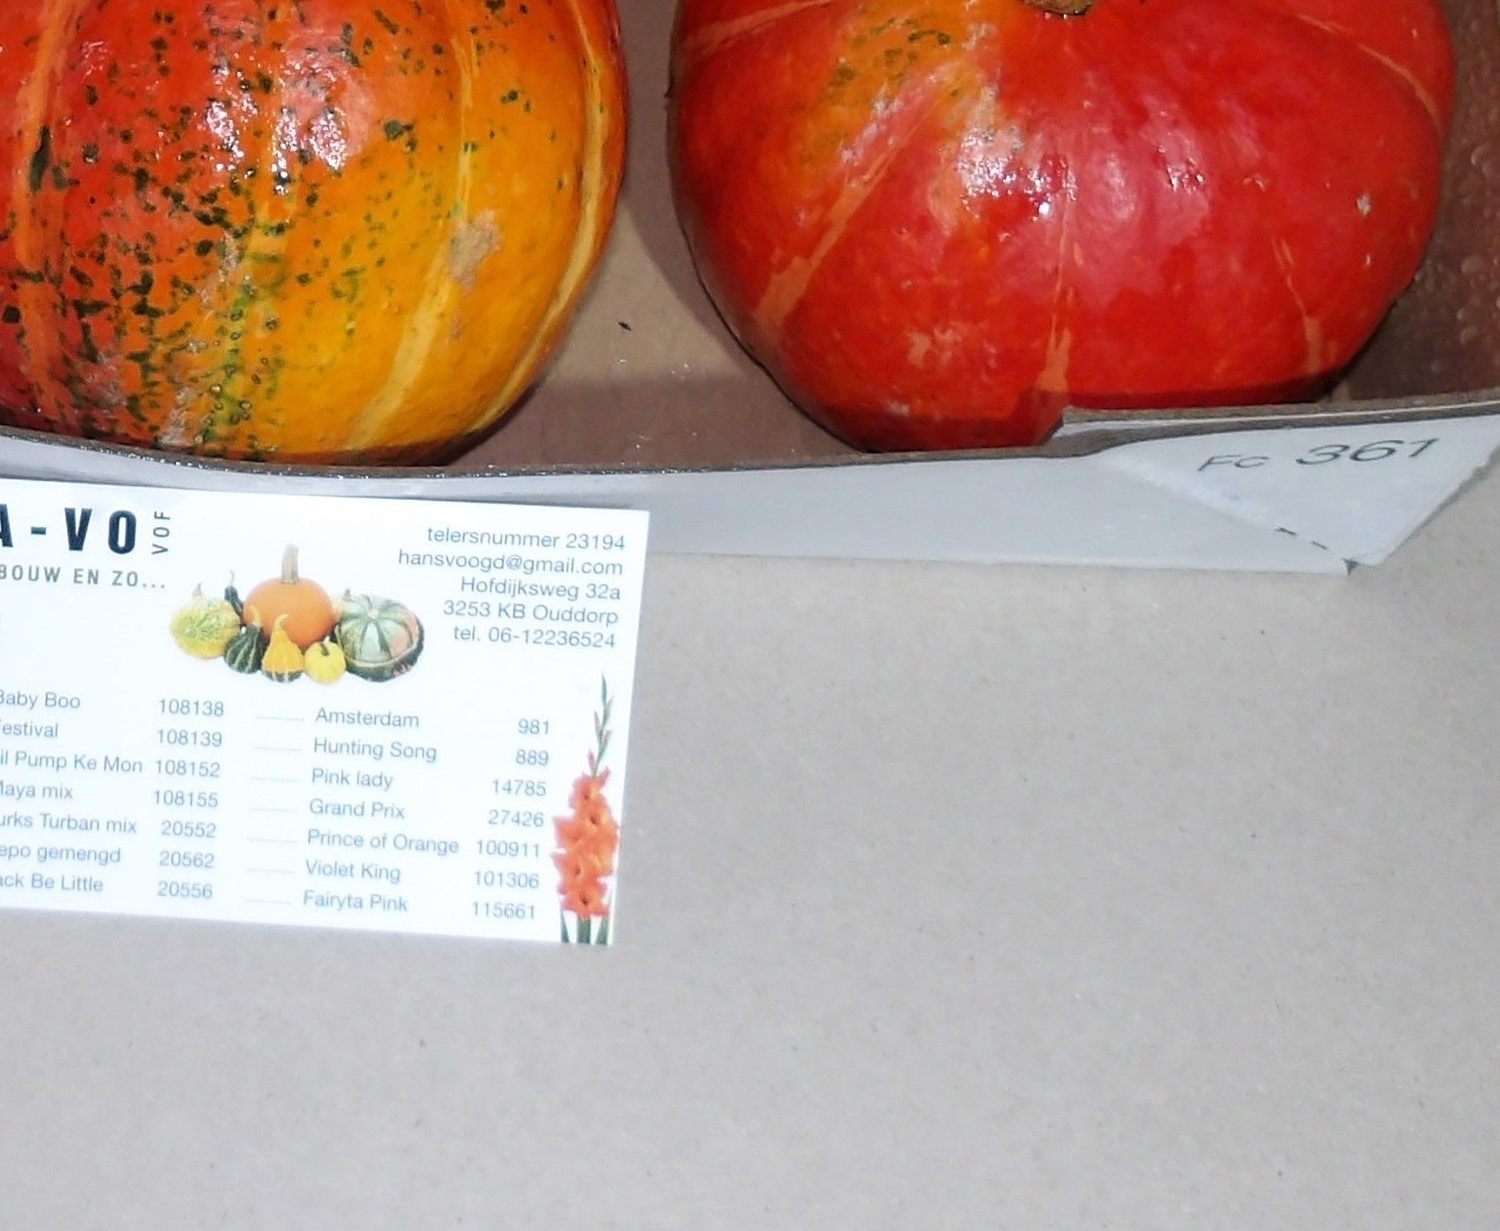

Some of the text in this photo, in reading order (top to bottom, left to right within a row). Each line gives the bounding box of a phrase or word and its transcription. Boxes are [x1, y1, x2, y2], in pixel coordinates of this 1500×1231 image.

[1296, 438, 1439, 466] 361
[151, 509, 171, 555] VOF
[427, 527, 625, 548] telersnummer 23194
[398, 549, 623, 576] hansvoogd@gmail.com
[73, 568, 99, 585] EN
[461, 577, 621, 601] Hofdijksweg 32a
[443, 600, 618, 625] 3253 KB Ouddorp
[453, 625, 615, 648] tel. 06-12236524
[45, 692, 81, 709] Boo
[159, 699, 224, 716] 108138
[315, 708, 549, 735] Amsterdam 981
[158, 729, 222, 747] 108139
[15, 751, 67, 770] Pump
[73, 754, 97, 770] Ke
[103, 757, 143, 773] Mon
[155, 760, 220, 778] 108152
[313, 738, 549, 766] Hunting Song 889
[311, 768, 546, 796] Pink lady 14785
[42, 784, 73, 799] mix
[154, 790, 218, 808] 108155
[40, 813, 100, 831] Turban
[106, 819, 137, 834] mix
[161, 820, 216, 838] 20552
[309, 799, 544, 828] Grand Prix 27426
[308, 829, 540, 858] Prince of Orange 100911
[37, 846, 121, 865] gemengd
[159, 851, 214, 868] 20562
[31, 874, 55, 889] Be
[61, 876, 104, 892] Little
[158, 881, 213, 899] 20556
[305, 860, 539, 889] Violet King 101306
[303, 890, 536, 919] Fairyta Pink 115661
